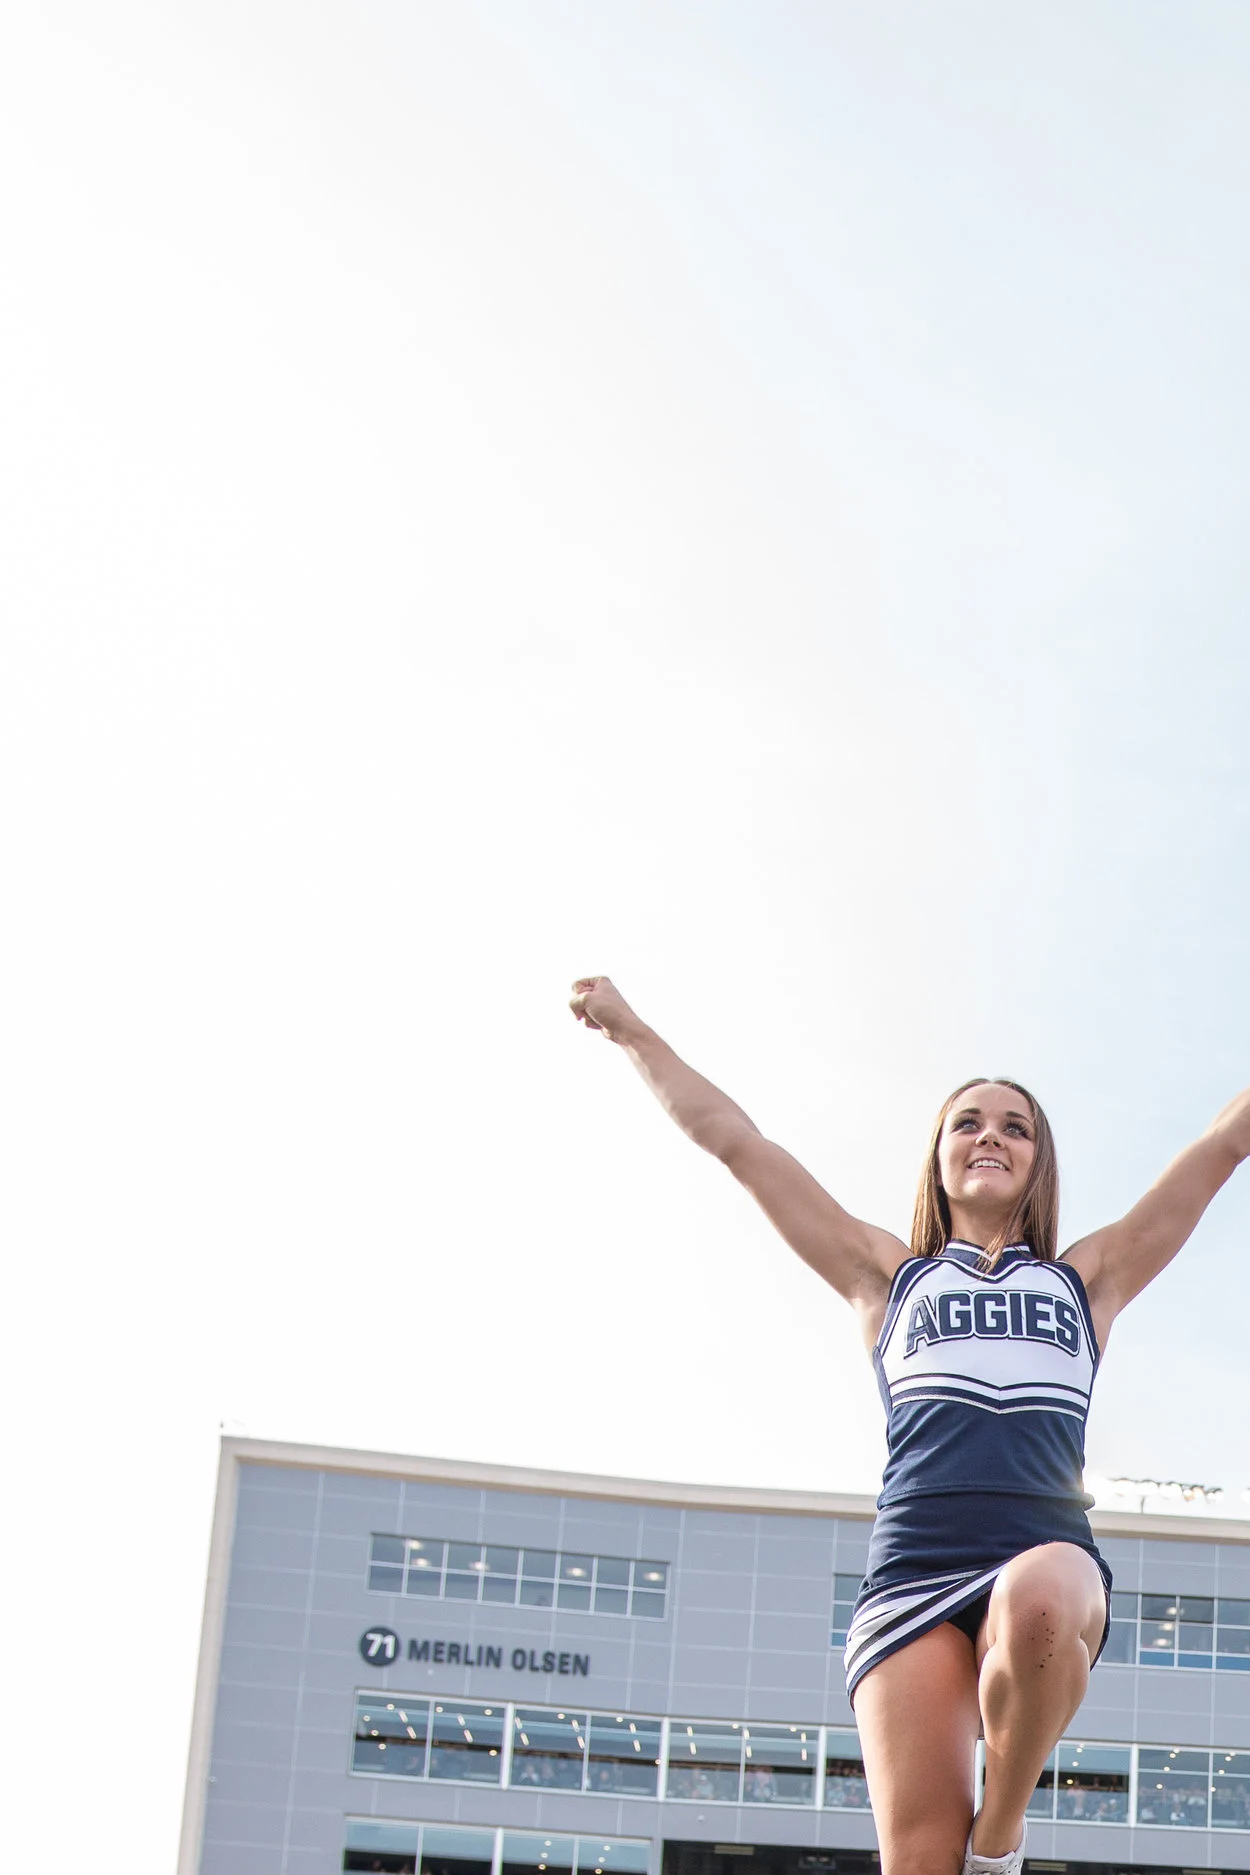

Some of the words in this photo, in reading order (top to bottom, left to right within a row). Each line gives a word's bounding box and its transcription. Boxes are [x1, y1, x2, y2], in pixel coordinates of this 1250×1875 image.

[903, 1290, 1081, 1359] AGGIES
[365, 1632, 396, 1659] 71
[409, 1640, 501, 1668] MERLIN
[512, 1649, 589, 1676] OLSEN
